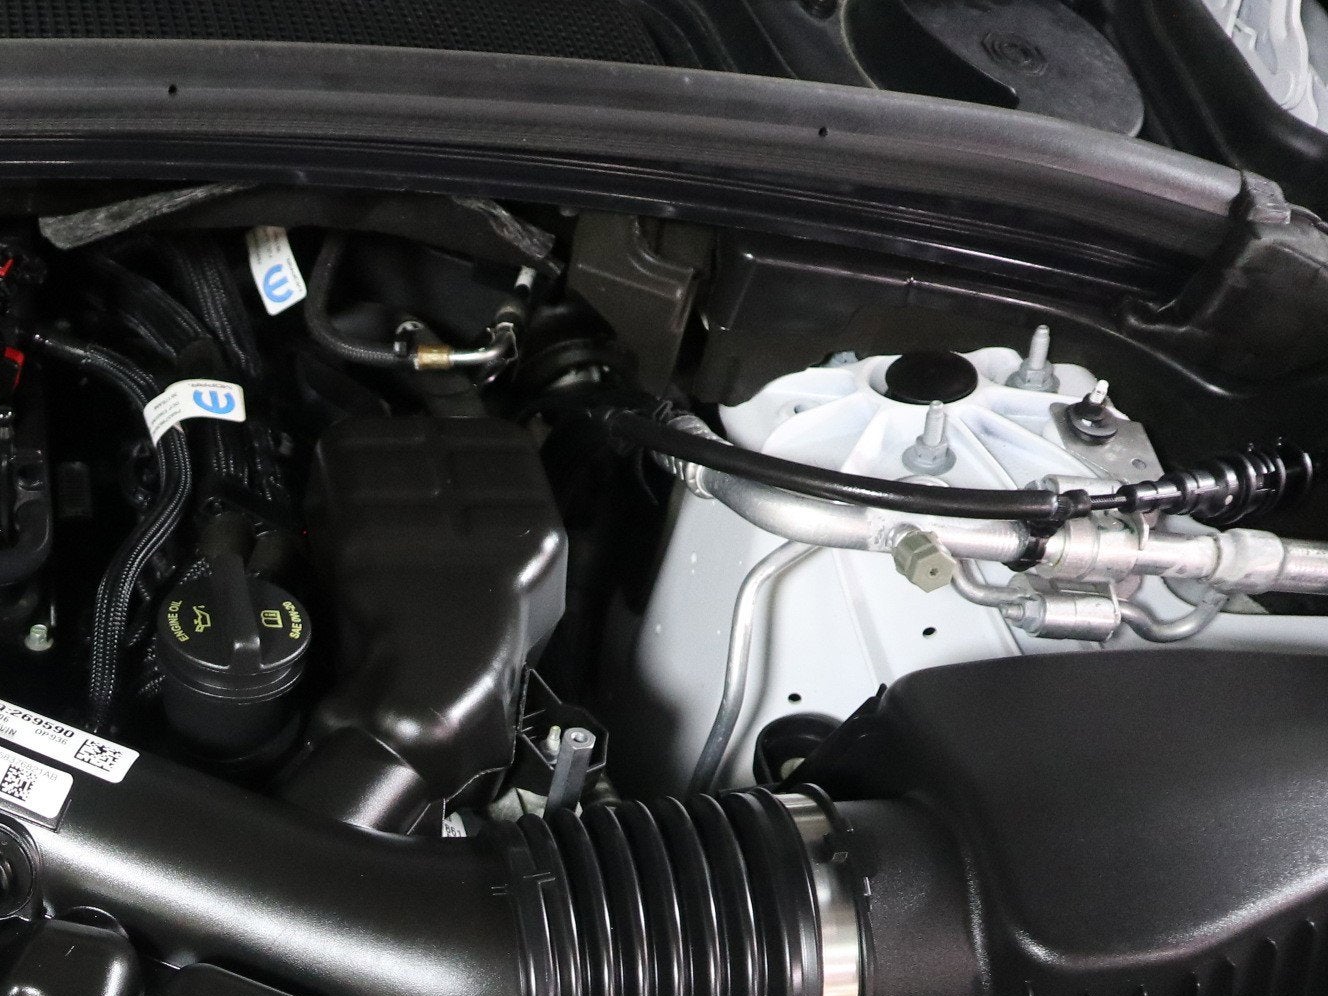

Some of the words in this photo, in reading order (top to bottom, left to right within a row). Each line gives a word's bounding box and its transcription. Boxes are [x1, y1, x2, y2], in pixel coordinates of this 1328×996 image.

[169, 600, 183, 612] OIL
[167, 613, 190, 642] ENGINE
[288, 622, 303, 640] SAE
